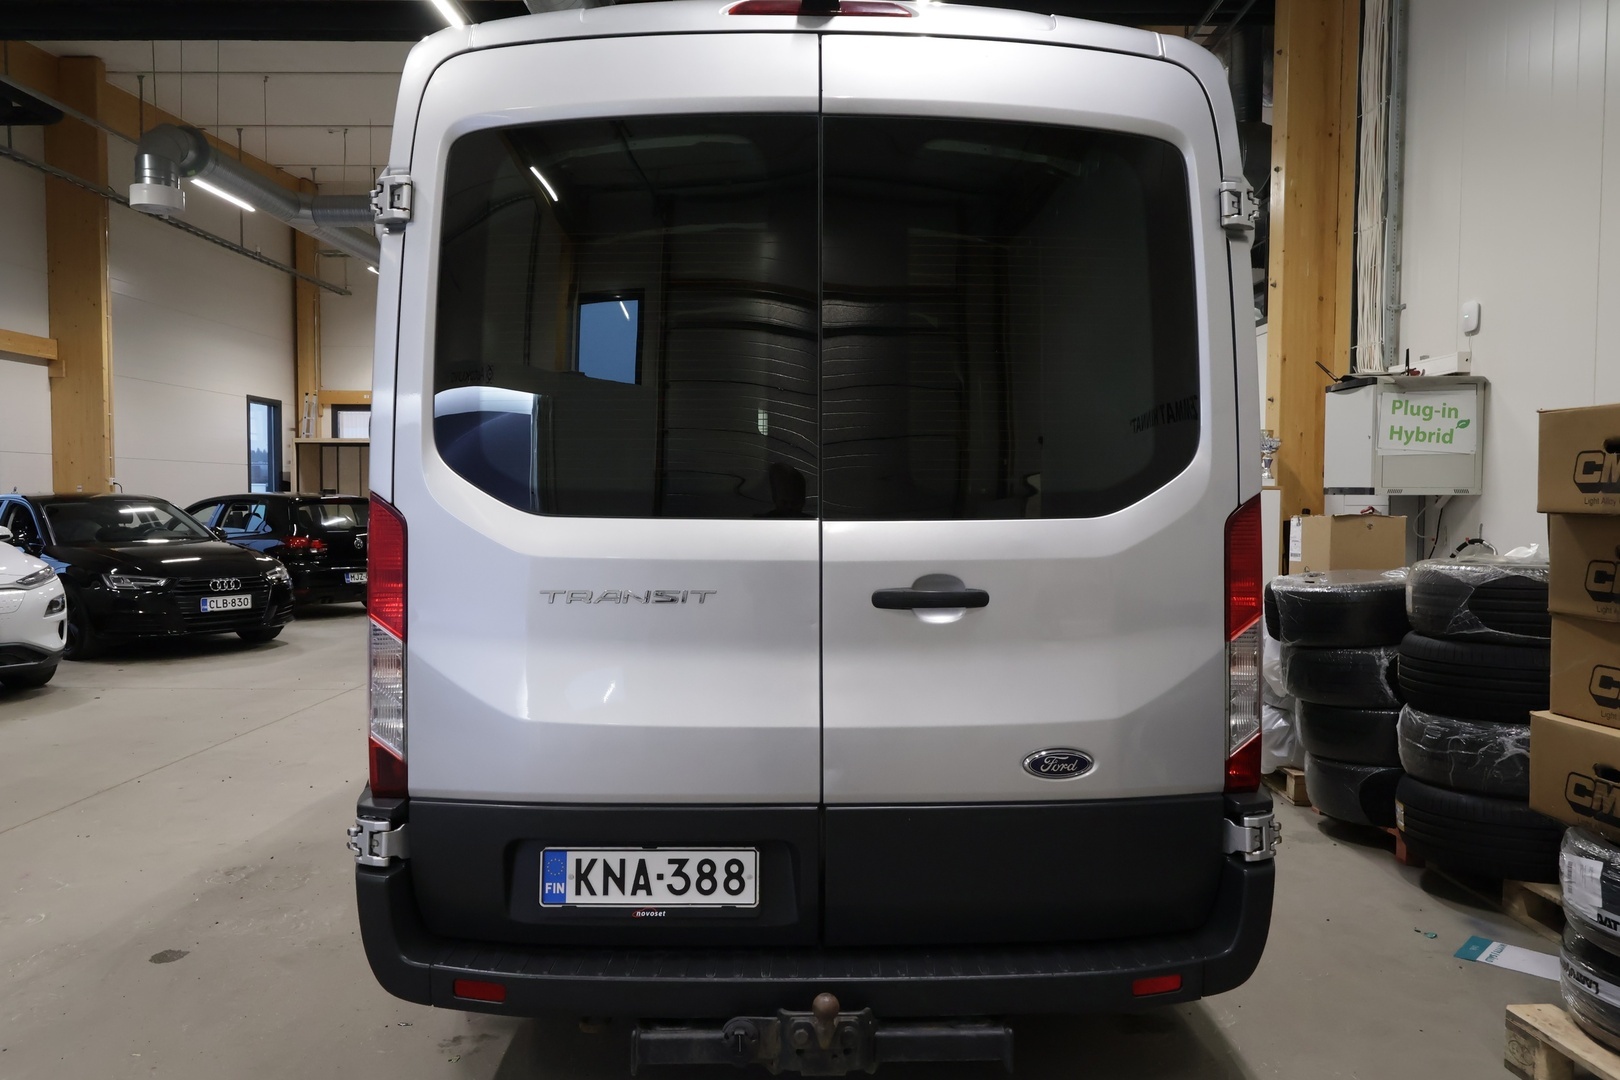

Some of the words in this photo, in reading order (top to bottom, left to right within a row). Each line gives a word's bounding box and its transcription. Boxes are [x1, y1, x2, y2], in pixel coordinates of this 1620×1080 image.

[1391, 399, 1459, 421] Plug-in
[1389, 425, 1454, 446] Hybrid
[1584, 497, 1599, 507] Light
[1601, 497, 1616, 506] Alloy
[1585, 560, 1620, 603] C
[209, 597, 249, 609] CLB-830
[539, 589, 717, 604] TRANSIT
[1589, 664, 1620, 709] C
[1040, 756, 1079, 772] Ford
[545, 882, 565, 894] FIN
[574, 858, 746, 896] KNA-388
[636, 909, 666, 917] novoset
